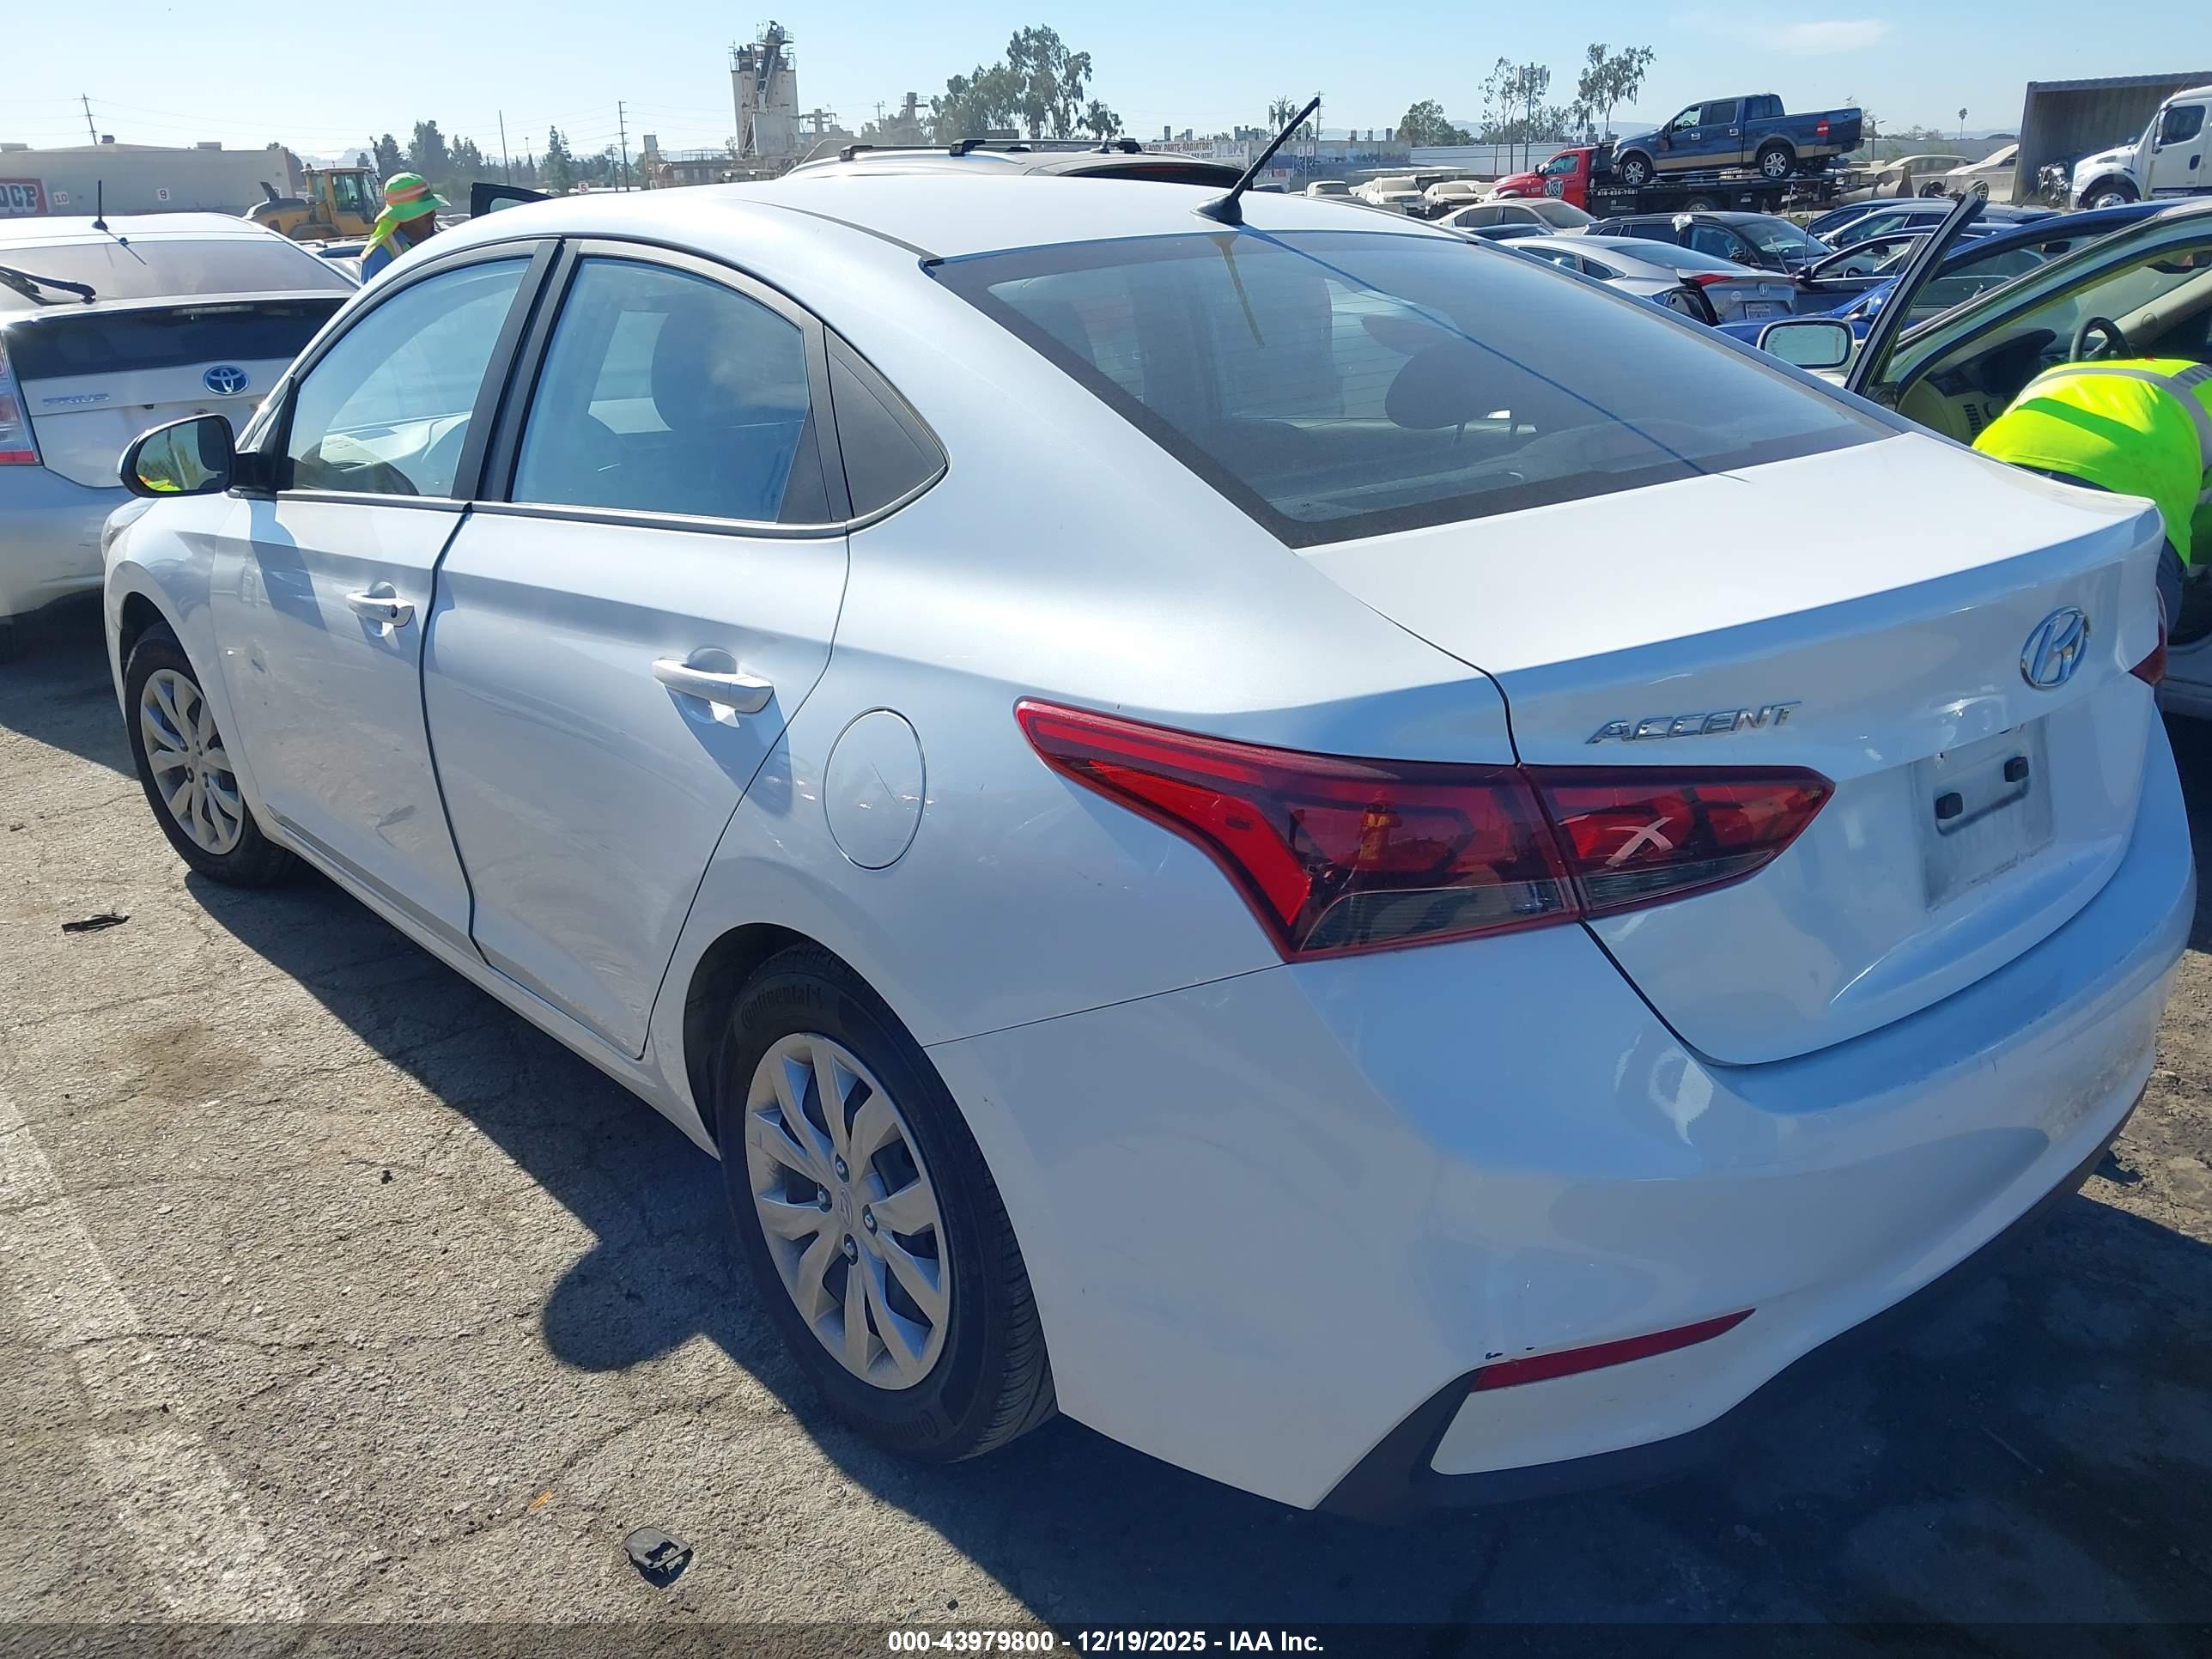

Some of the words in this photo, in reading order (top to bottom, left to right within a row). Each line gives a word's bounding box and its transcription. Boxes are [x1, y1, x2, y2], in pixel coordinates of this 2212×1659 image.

[55, 193, 69, 204] 10
[159, 189, 167, 199] 9
[1584, 700, 1802, 744] ACCENT
